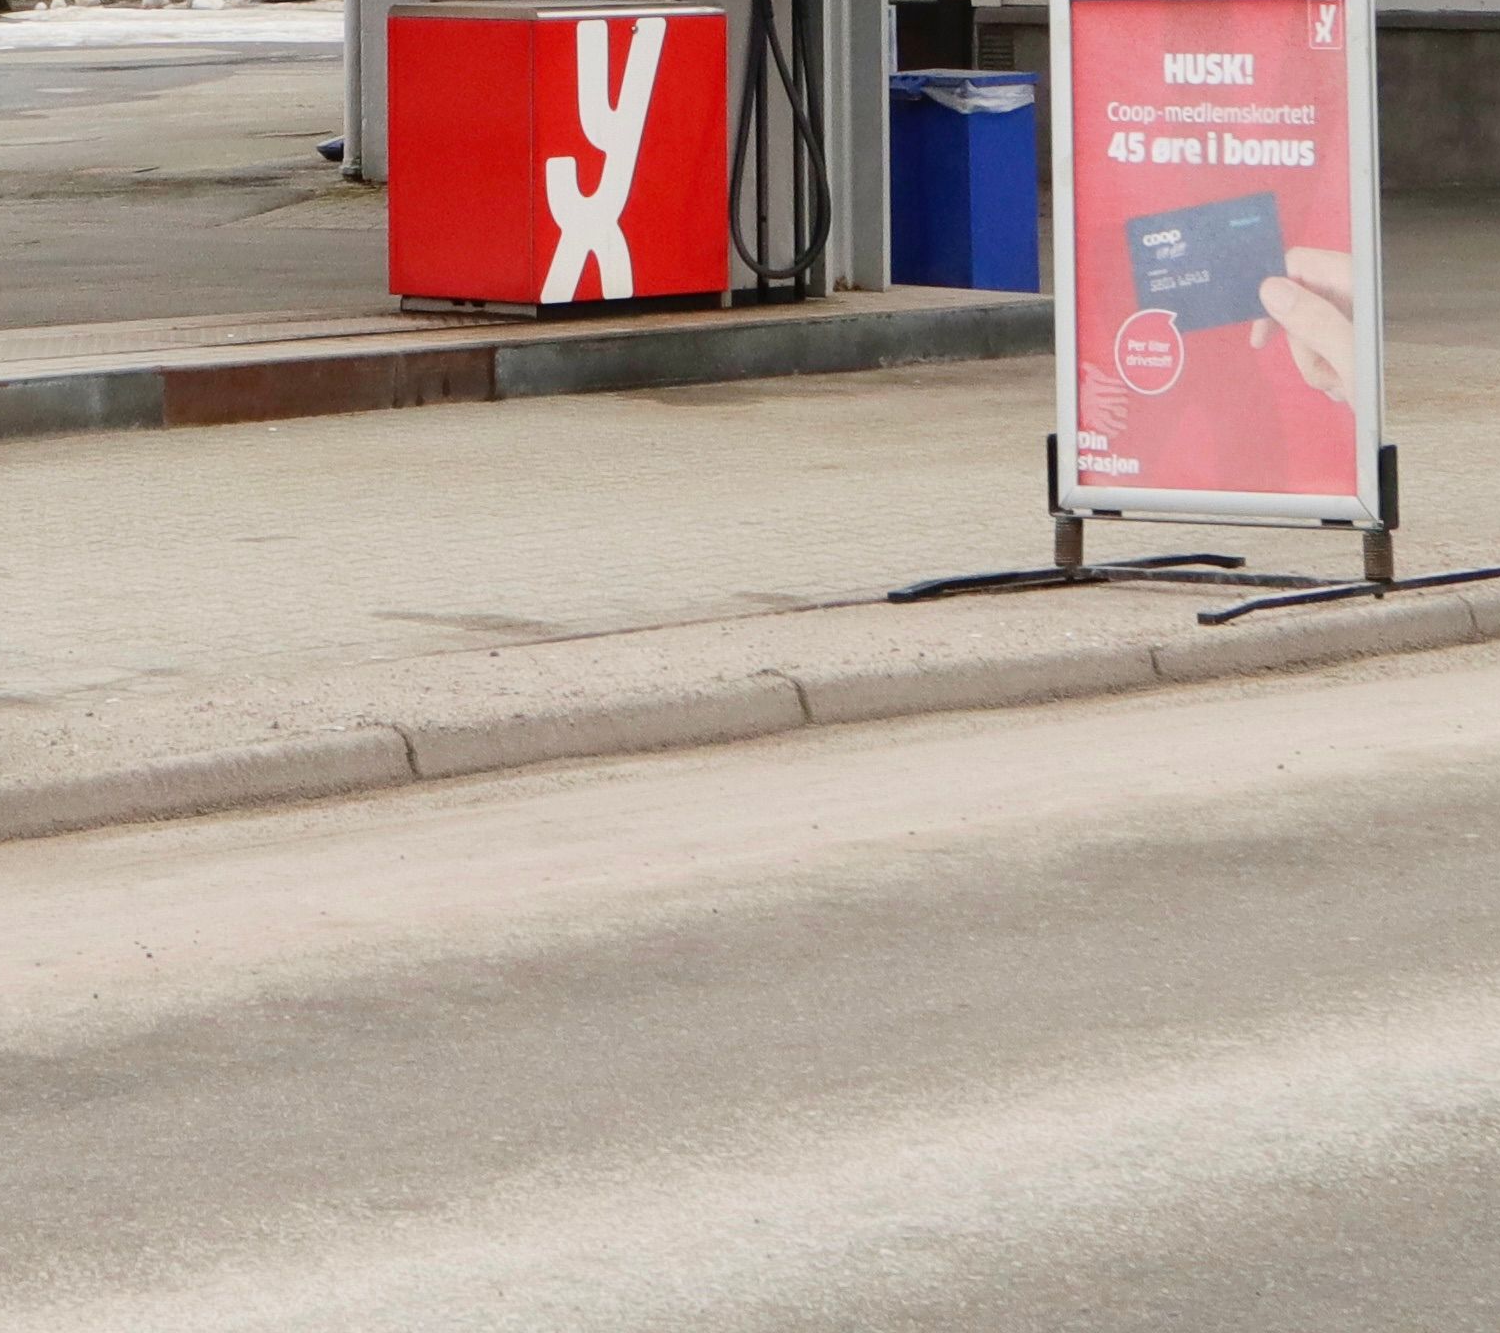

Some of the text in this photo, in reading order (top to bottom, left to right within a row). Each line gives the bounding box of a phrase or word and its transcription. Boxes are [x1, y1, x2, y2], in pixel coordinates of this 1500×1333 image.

[1163, 53, 1254, 85] HUSK!
[1107, 101, 1315, 125] Coop-medlemskortet!
[1108, 132, 1315, 166] 45 øre i bonus
[1143, 229, 1181, 246] coop
[1078, 431, 1108, 451] Din
[1077, 453, 1139, 476] stasjon
